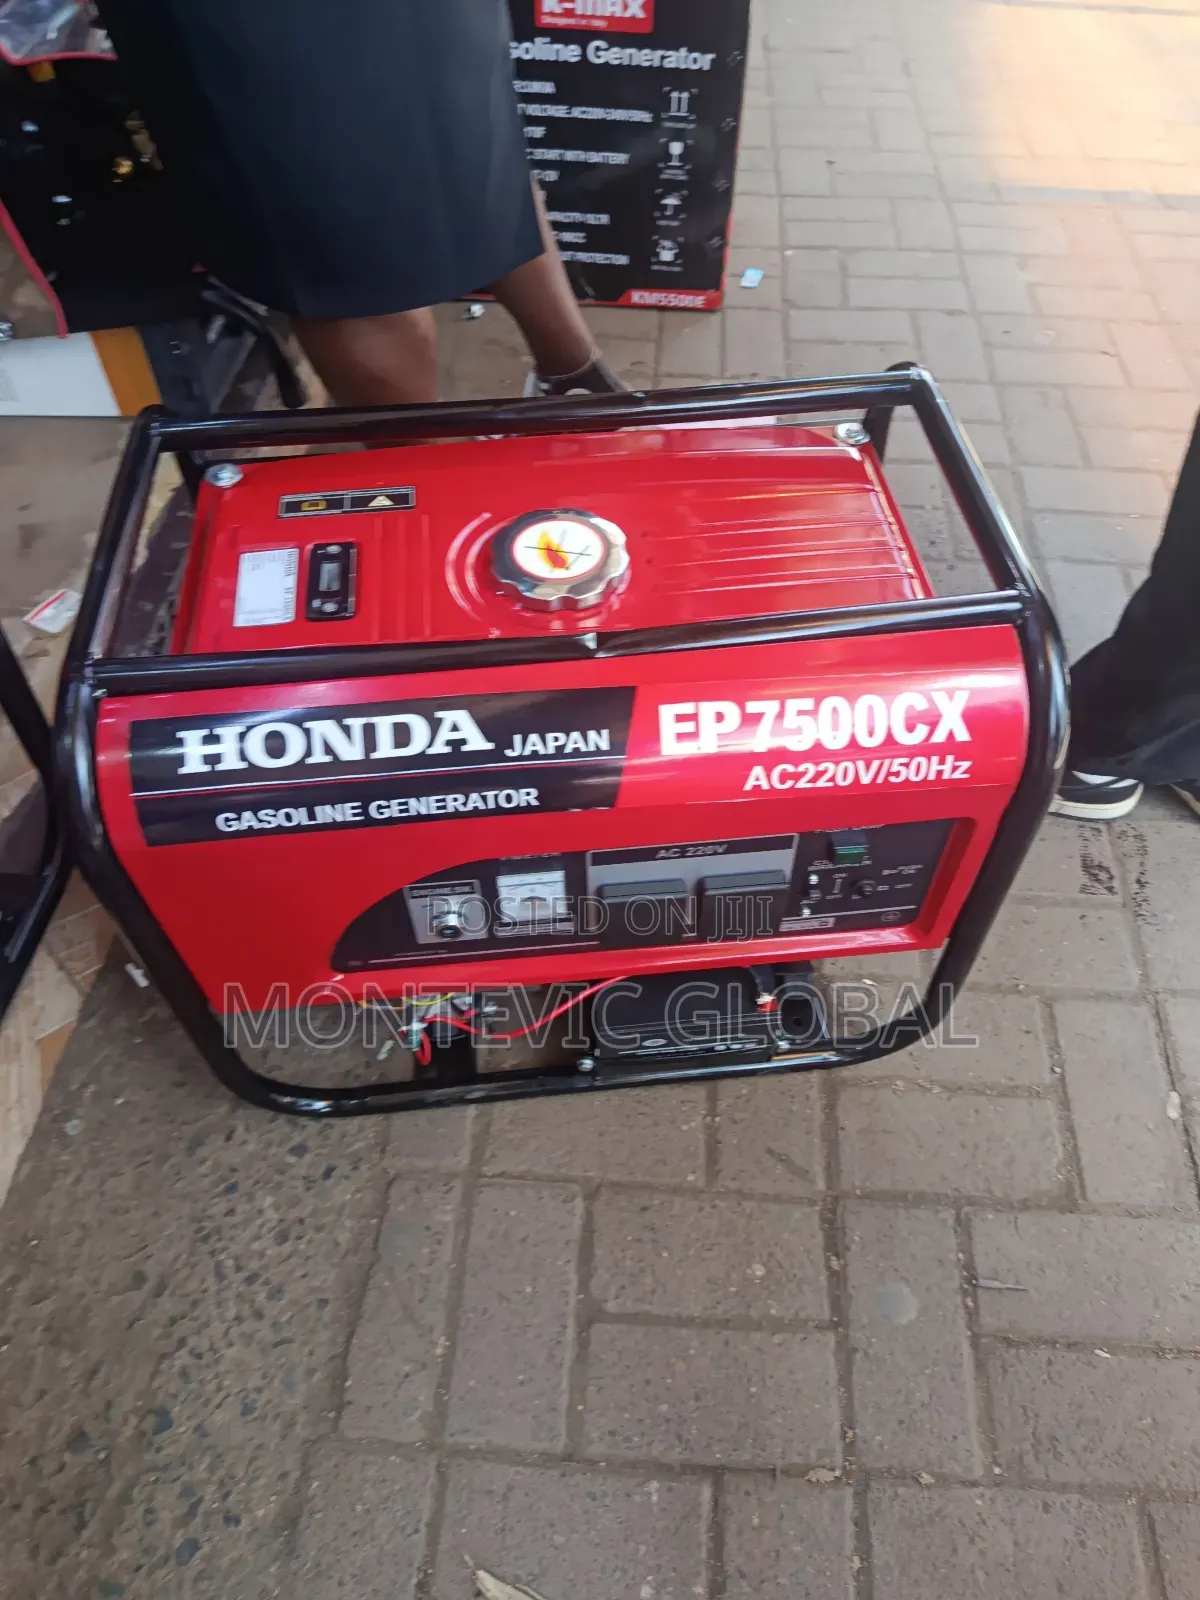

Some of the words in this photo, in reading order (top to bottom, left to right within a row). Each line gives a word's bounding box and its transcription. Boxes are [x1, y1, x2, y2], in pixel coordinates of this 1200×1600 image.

[586, 40, 717, 71] Generator
[176, 709, 496, 775] HONDA
[503, 729, 611, 758] JAPAN
[658, 690, 973, 756] EP7500CX
[743, 755, 973, 791] AC220V/50Hz
[215, 801, 365, 833] GASOLINE
[368, 787, 541, 819] GENERATOR
[655, 848, 681, 859] AC
[685, 844, 729, 856] 220V
